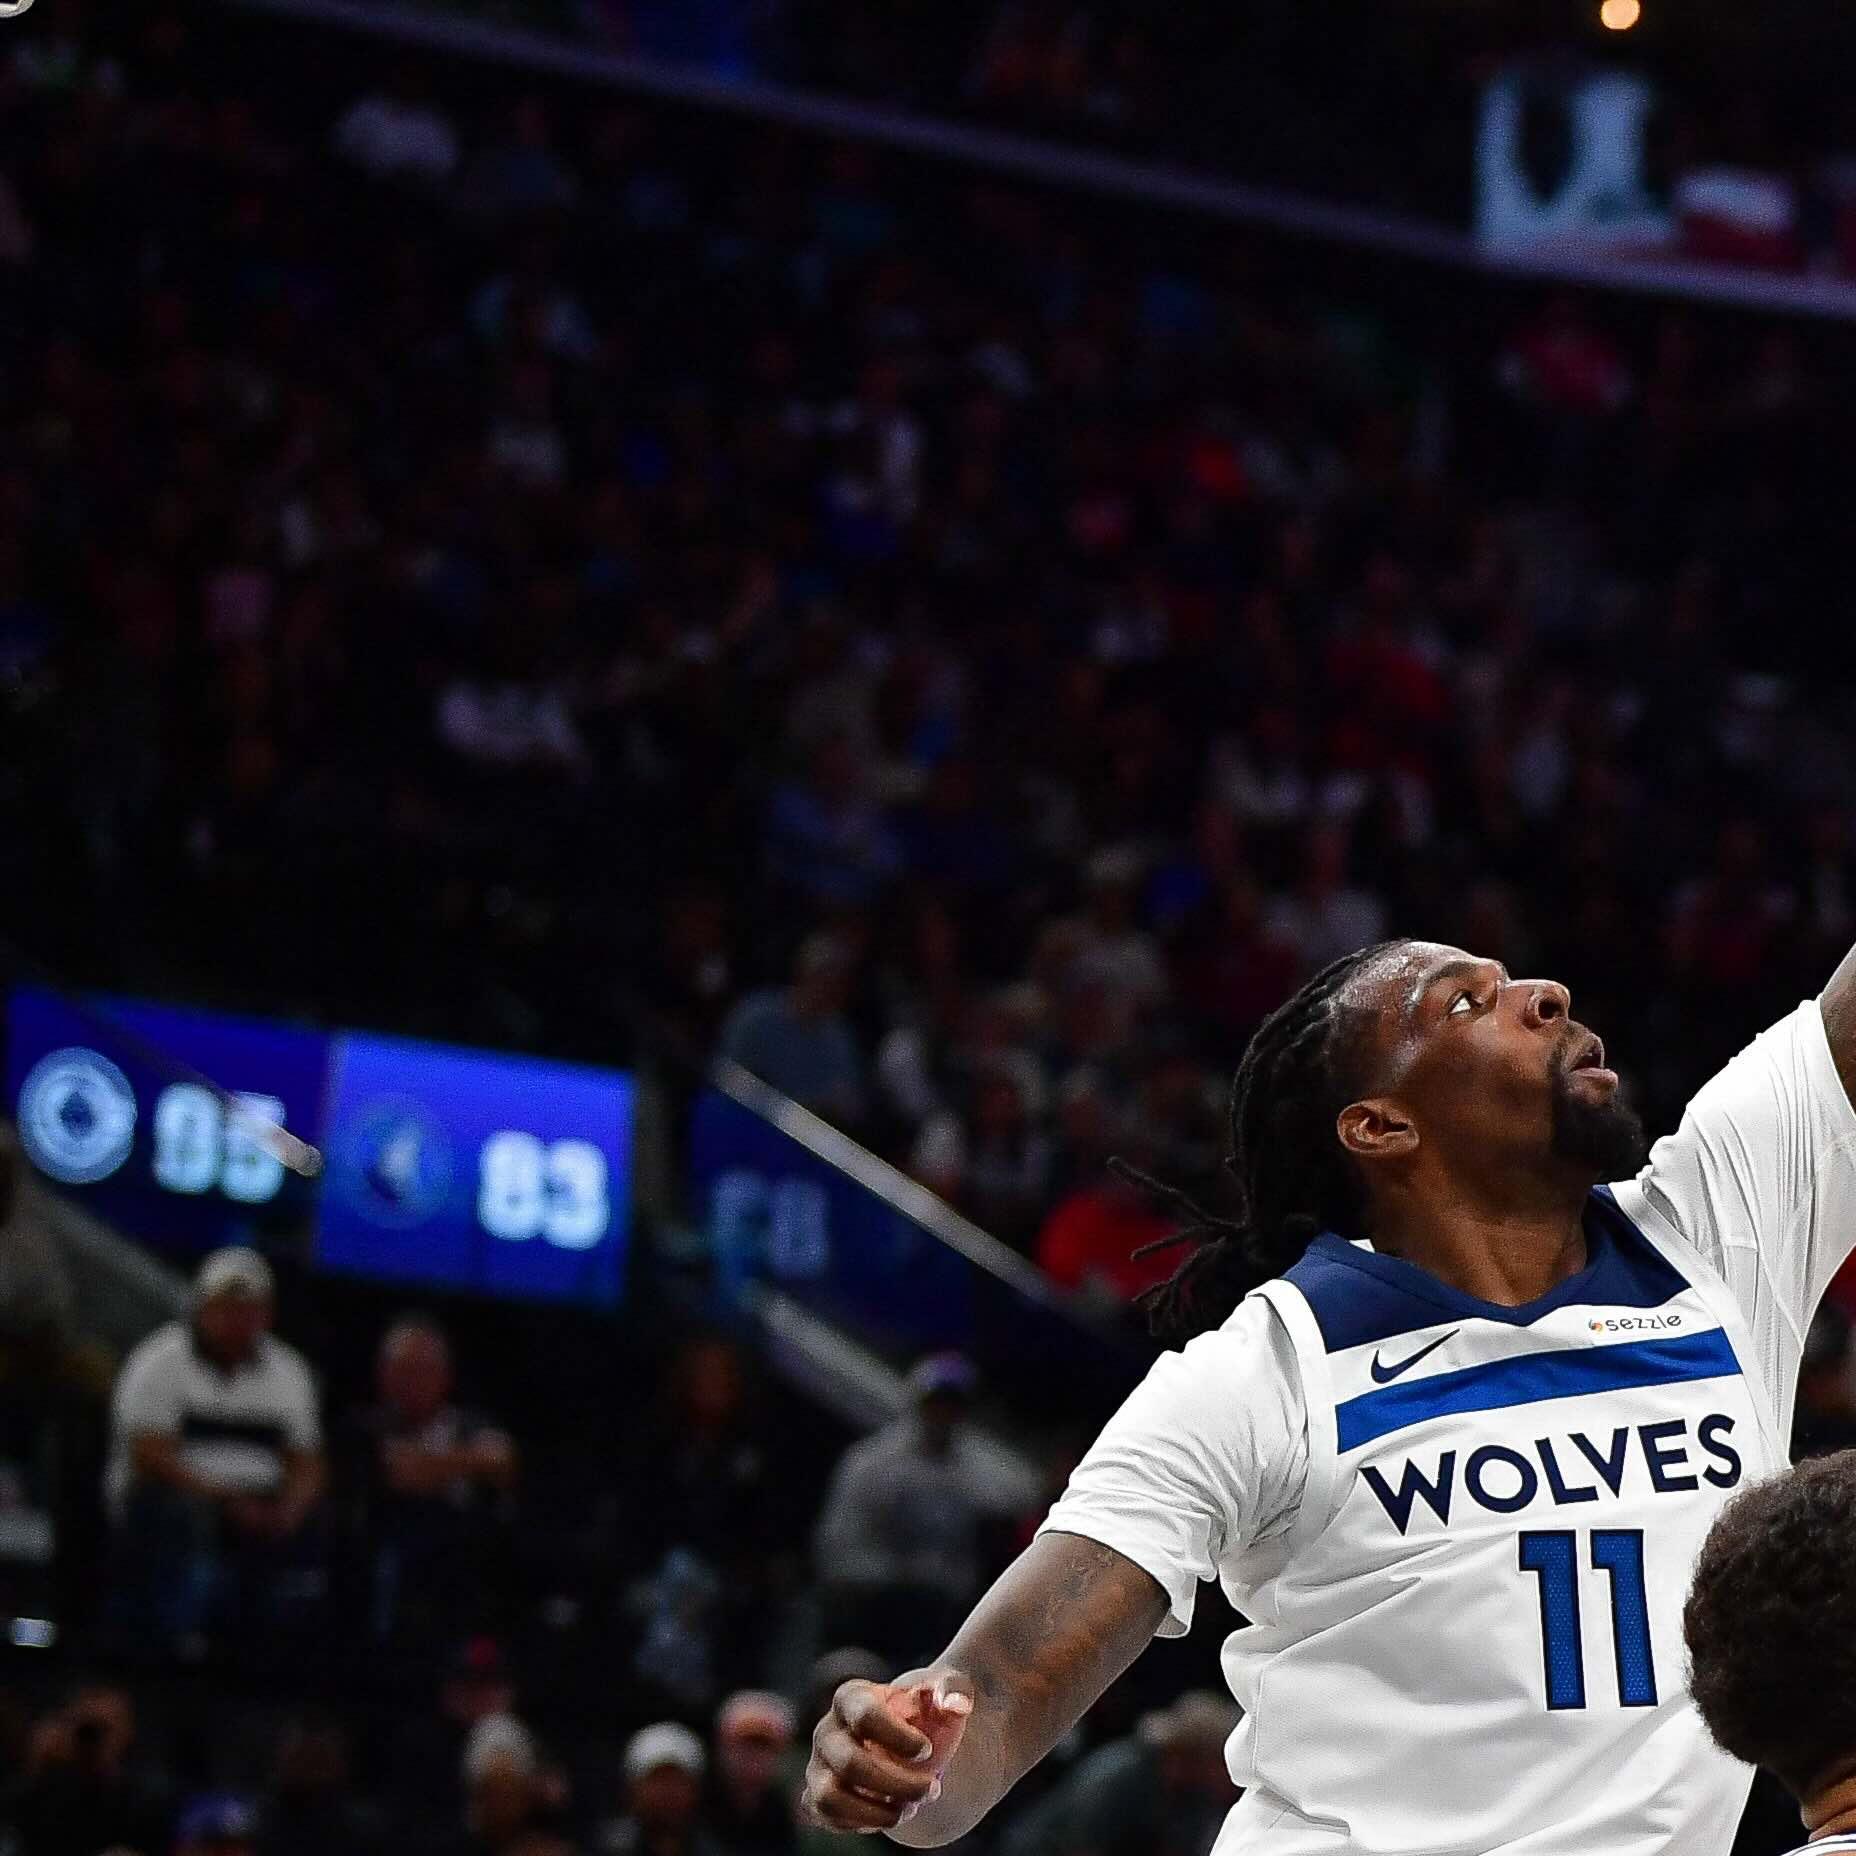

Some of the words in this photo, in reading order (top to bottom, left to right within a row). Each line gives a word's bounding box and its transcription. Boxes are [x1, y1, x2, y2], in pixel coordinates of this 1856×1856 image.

[1604, 1314, 1682, 1332] sezzle
[1358, 1413, 1743, 1537] WOLVES
[1517, 1528, 1659, 1711] 11
